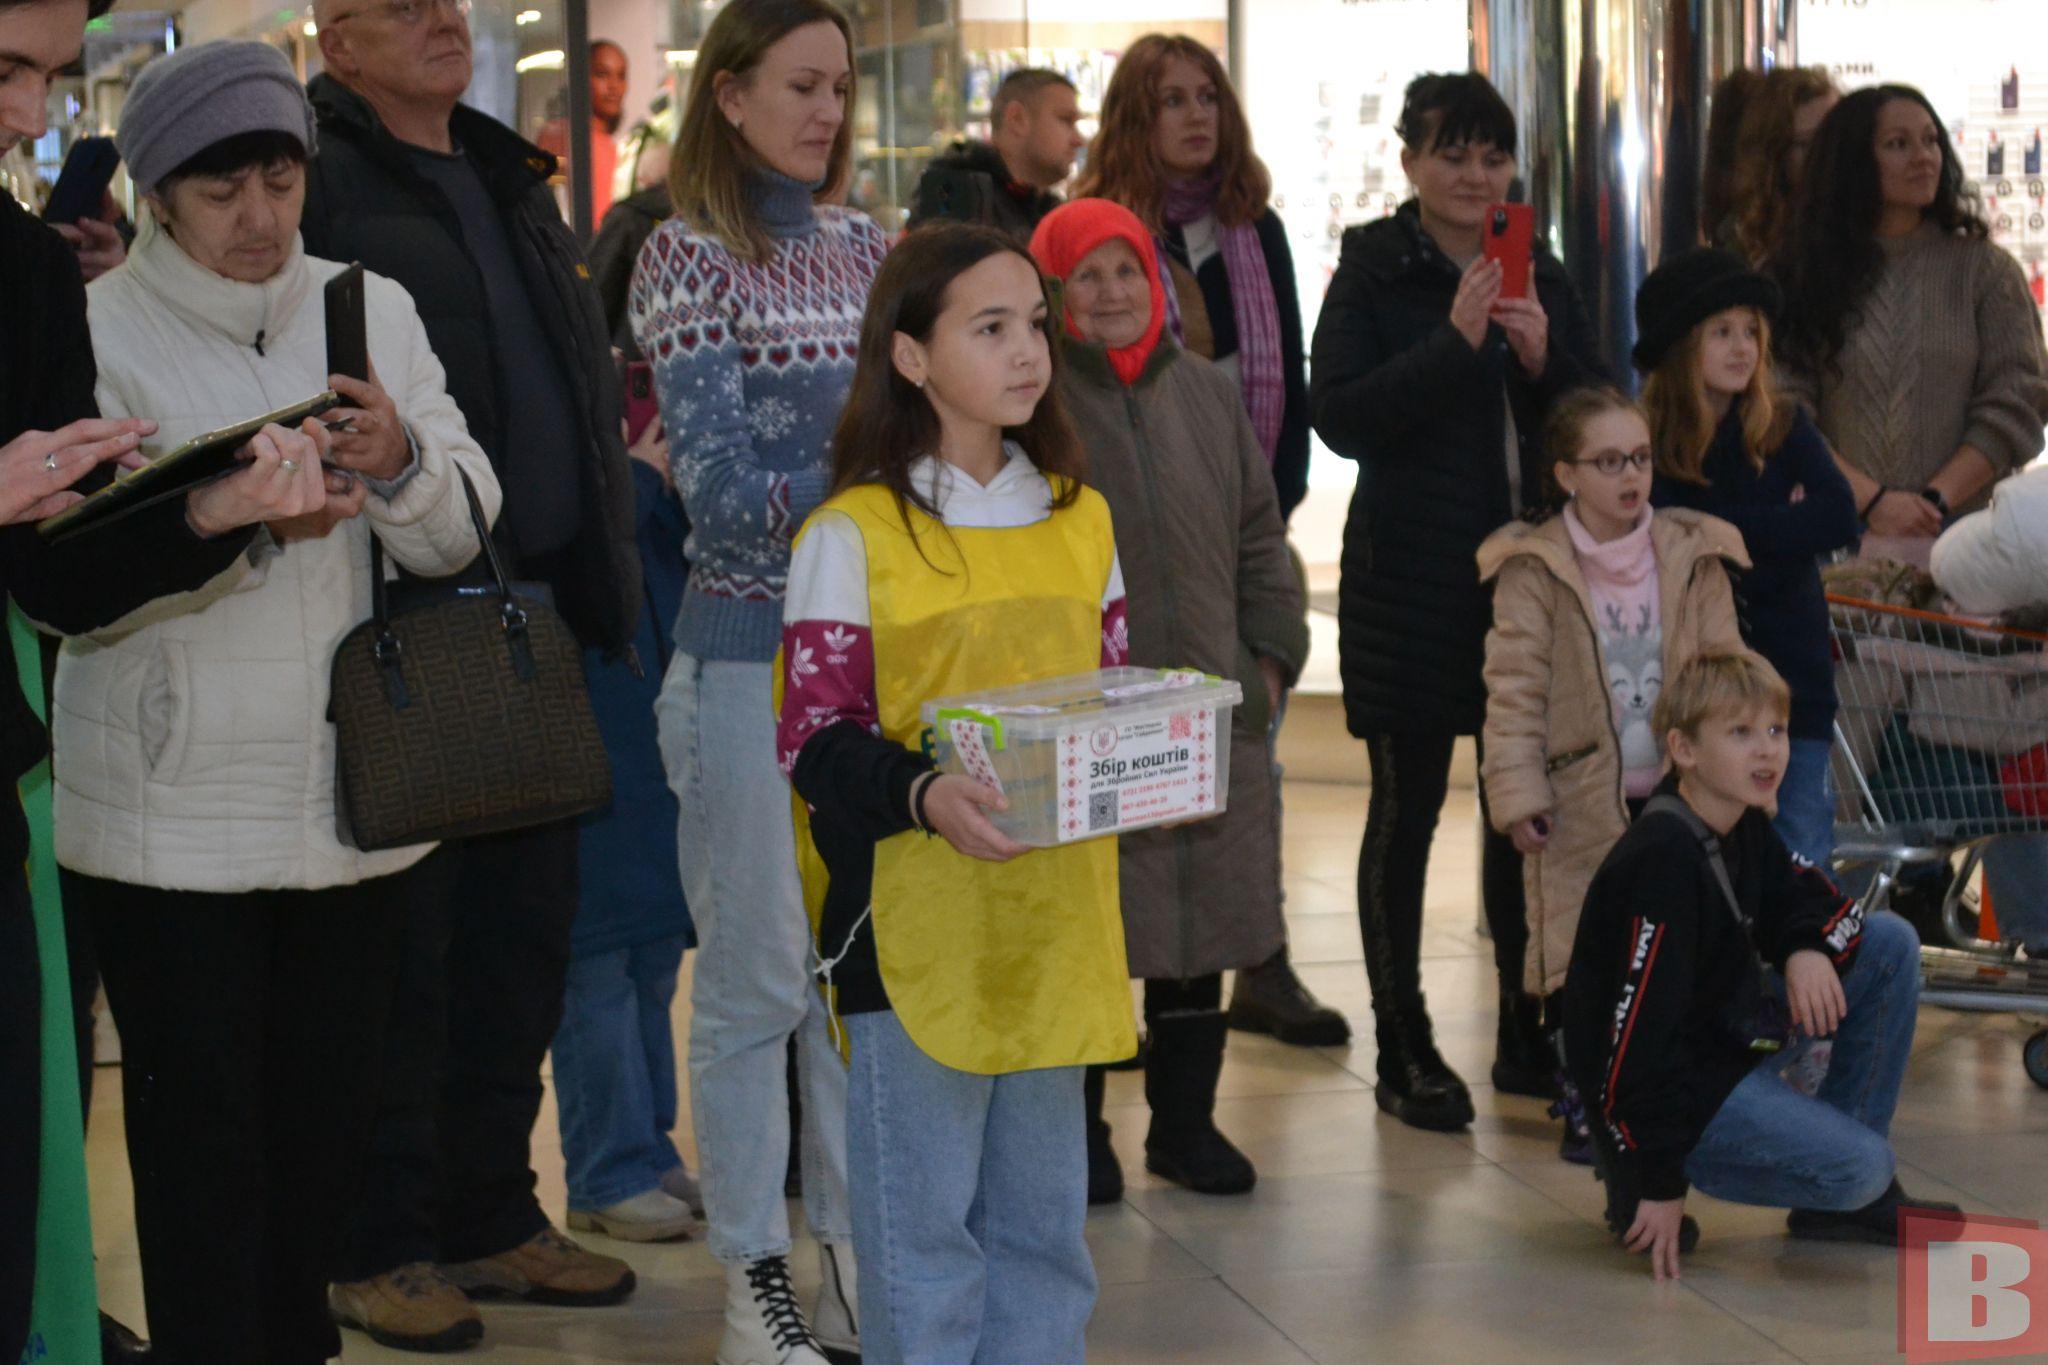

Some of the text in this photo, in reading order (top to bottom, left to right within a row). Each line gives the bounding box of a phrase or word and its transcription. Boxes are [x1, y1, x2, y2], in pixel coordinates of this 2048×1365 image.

[1089, 745, 1189, 779] Збір коштів
[1090, 764, 1188, 790] для Збройних Сил України
